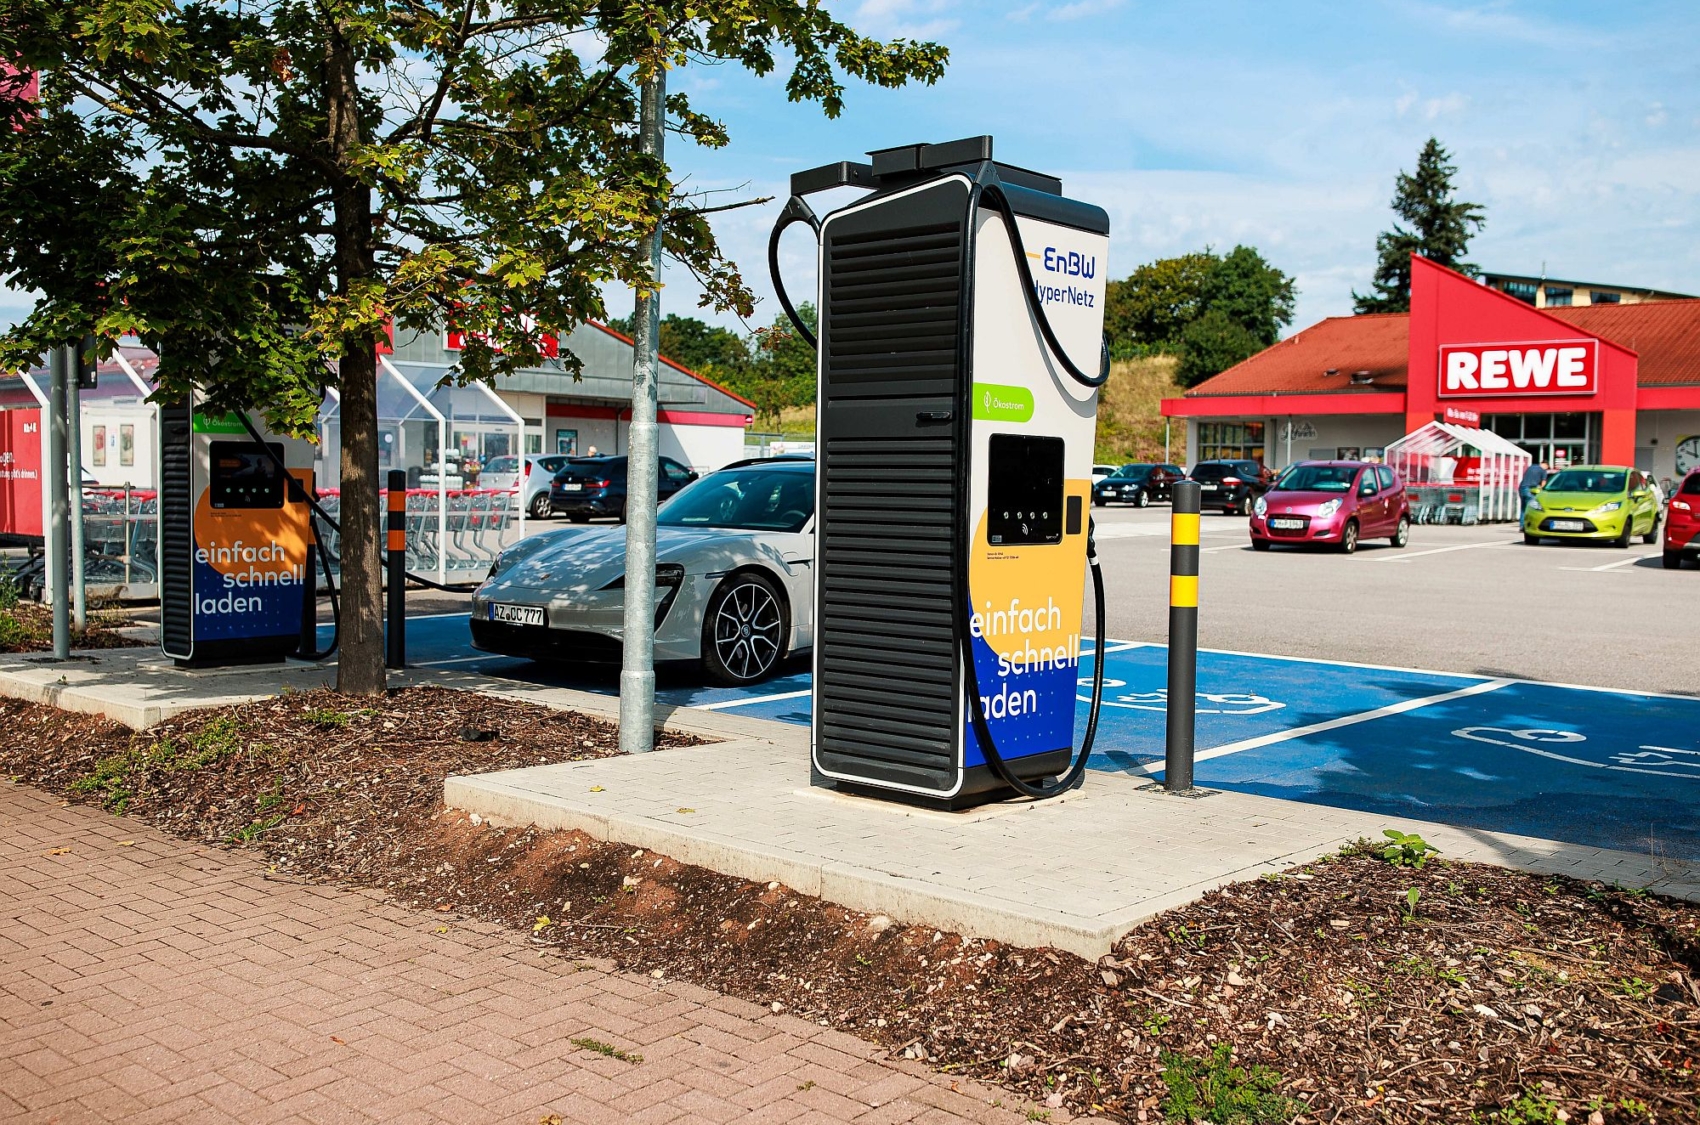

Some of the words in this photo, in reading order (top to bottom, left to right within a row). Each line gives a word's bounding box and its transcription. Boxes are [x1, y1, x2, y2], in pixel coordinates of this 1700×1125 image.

[1044, 246, 1095, 280] EnBW
[1447, 347, 1588, 390] REWE
[992, 397, 1025, 411] Ökostrom
[194, 540, 285, 564] einfach
[222, 564, 304, 589] schnell
[195, 591, 262, 615] laden
[494, 604, 506, 620] AZ
[510, 607, 522, 621] CC
[524, 608, 542, 623] 777
[970, 596, 1061, 638] einfach
[997, 633, 1079, 677] schnell
